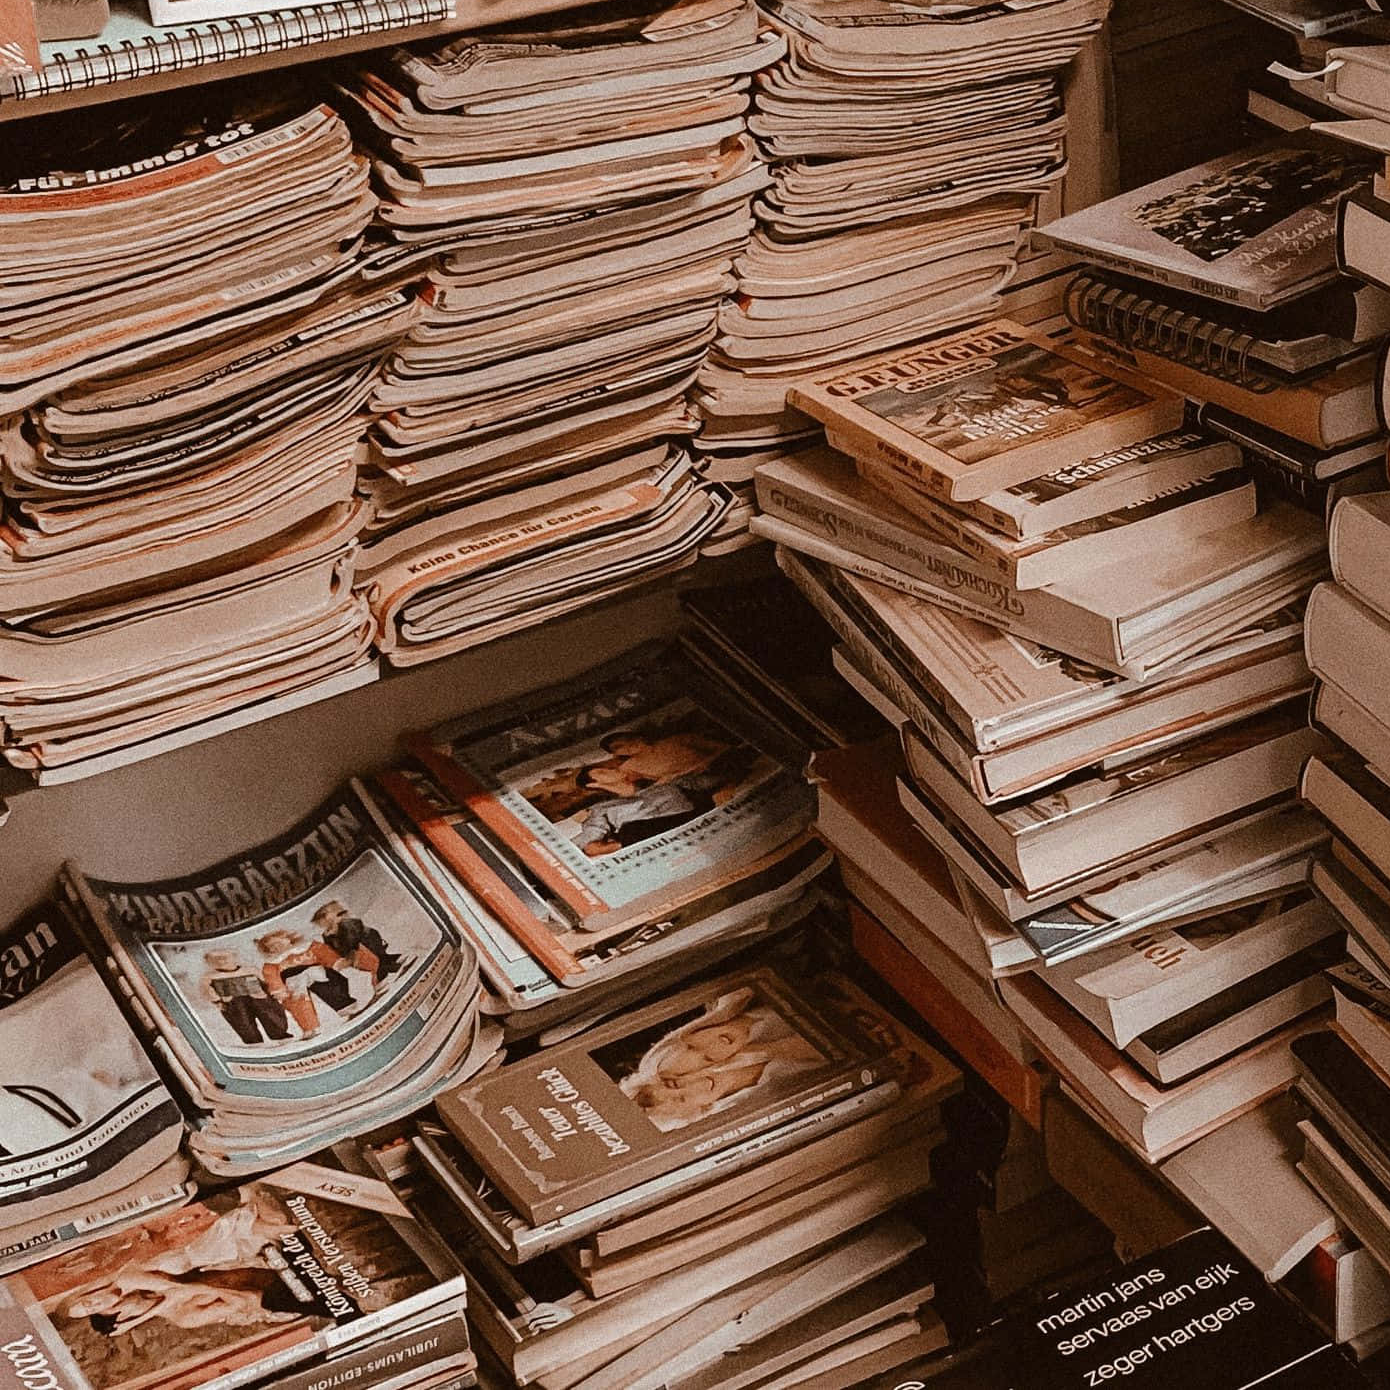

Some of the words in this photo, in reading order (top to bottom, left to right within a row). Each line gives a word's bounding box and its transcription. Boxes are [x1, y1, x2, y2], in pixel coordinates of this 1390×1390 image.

[93, 146, 200, 183] immer
[203, 122, 255, 148] tot
[1053, 425, 1203, 488] Schmutzigen
[407, 548, 455, 574] Keine
[456, 527, 518, 557] Chance
[520, 518, 544, 536] für
[543, 498, 603, 527] Carson
[316, 1183, 355, 1198] SEXY
[280, 1231, 304, 1255] der
[285, 1195, 343, 1262] Versuchung
[299, 1251, 355, 1318] Königreich
[338, 1255, 375, 1300] süßen
[1033, 1285, 1116, 1335] martin
[1113, 1263, 1168, 1301] jans
[1055, 1301, 1153, 1357] servaas
[1149, 1281, 1197, 1313] van
[1191, 1257, 1240, 1294] eijk
[1080, 1342, 1155, 1390] zeger
[1151, 1294, 1258, 1355] hartgers
